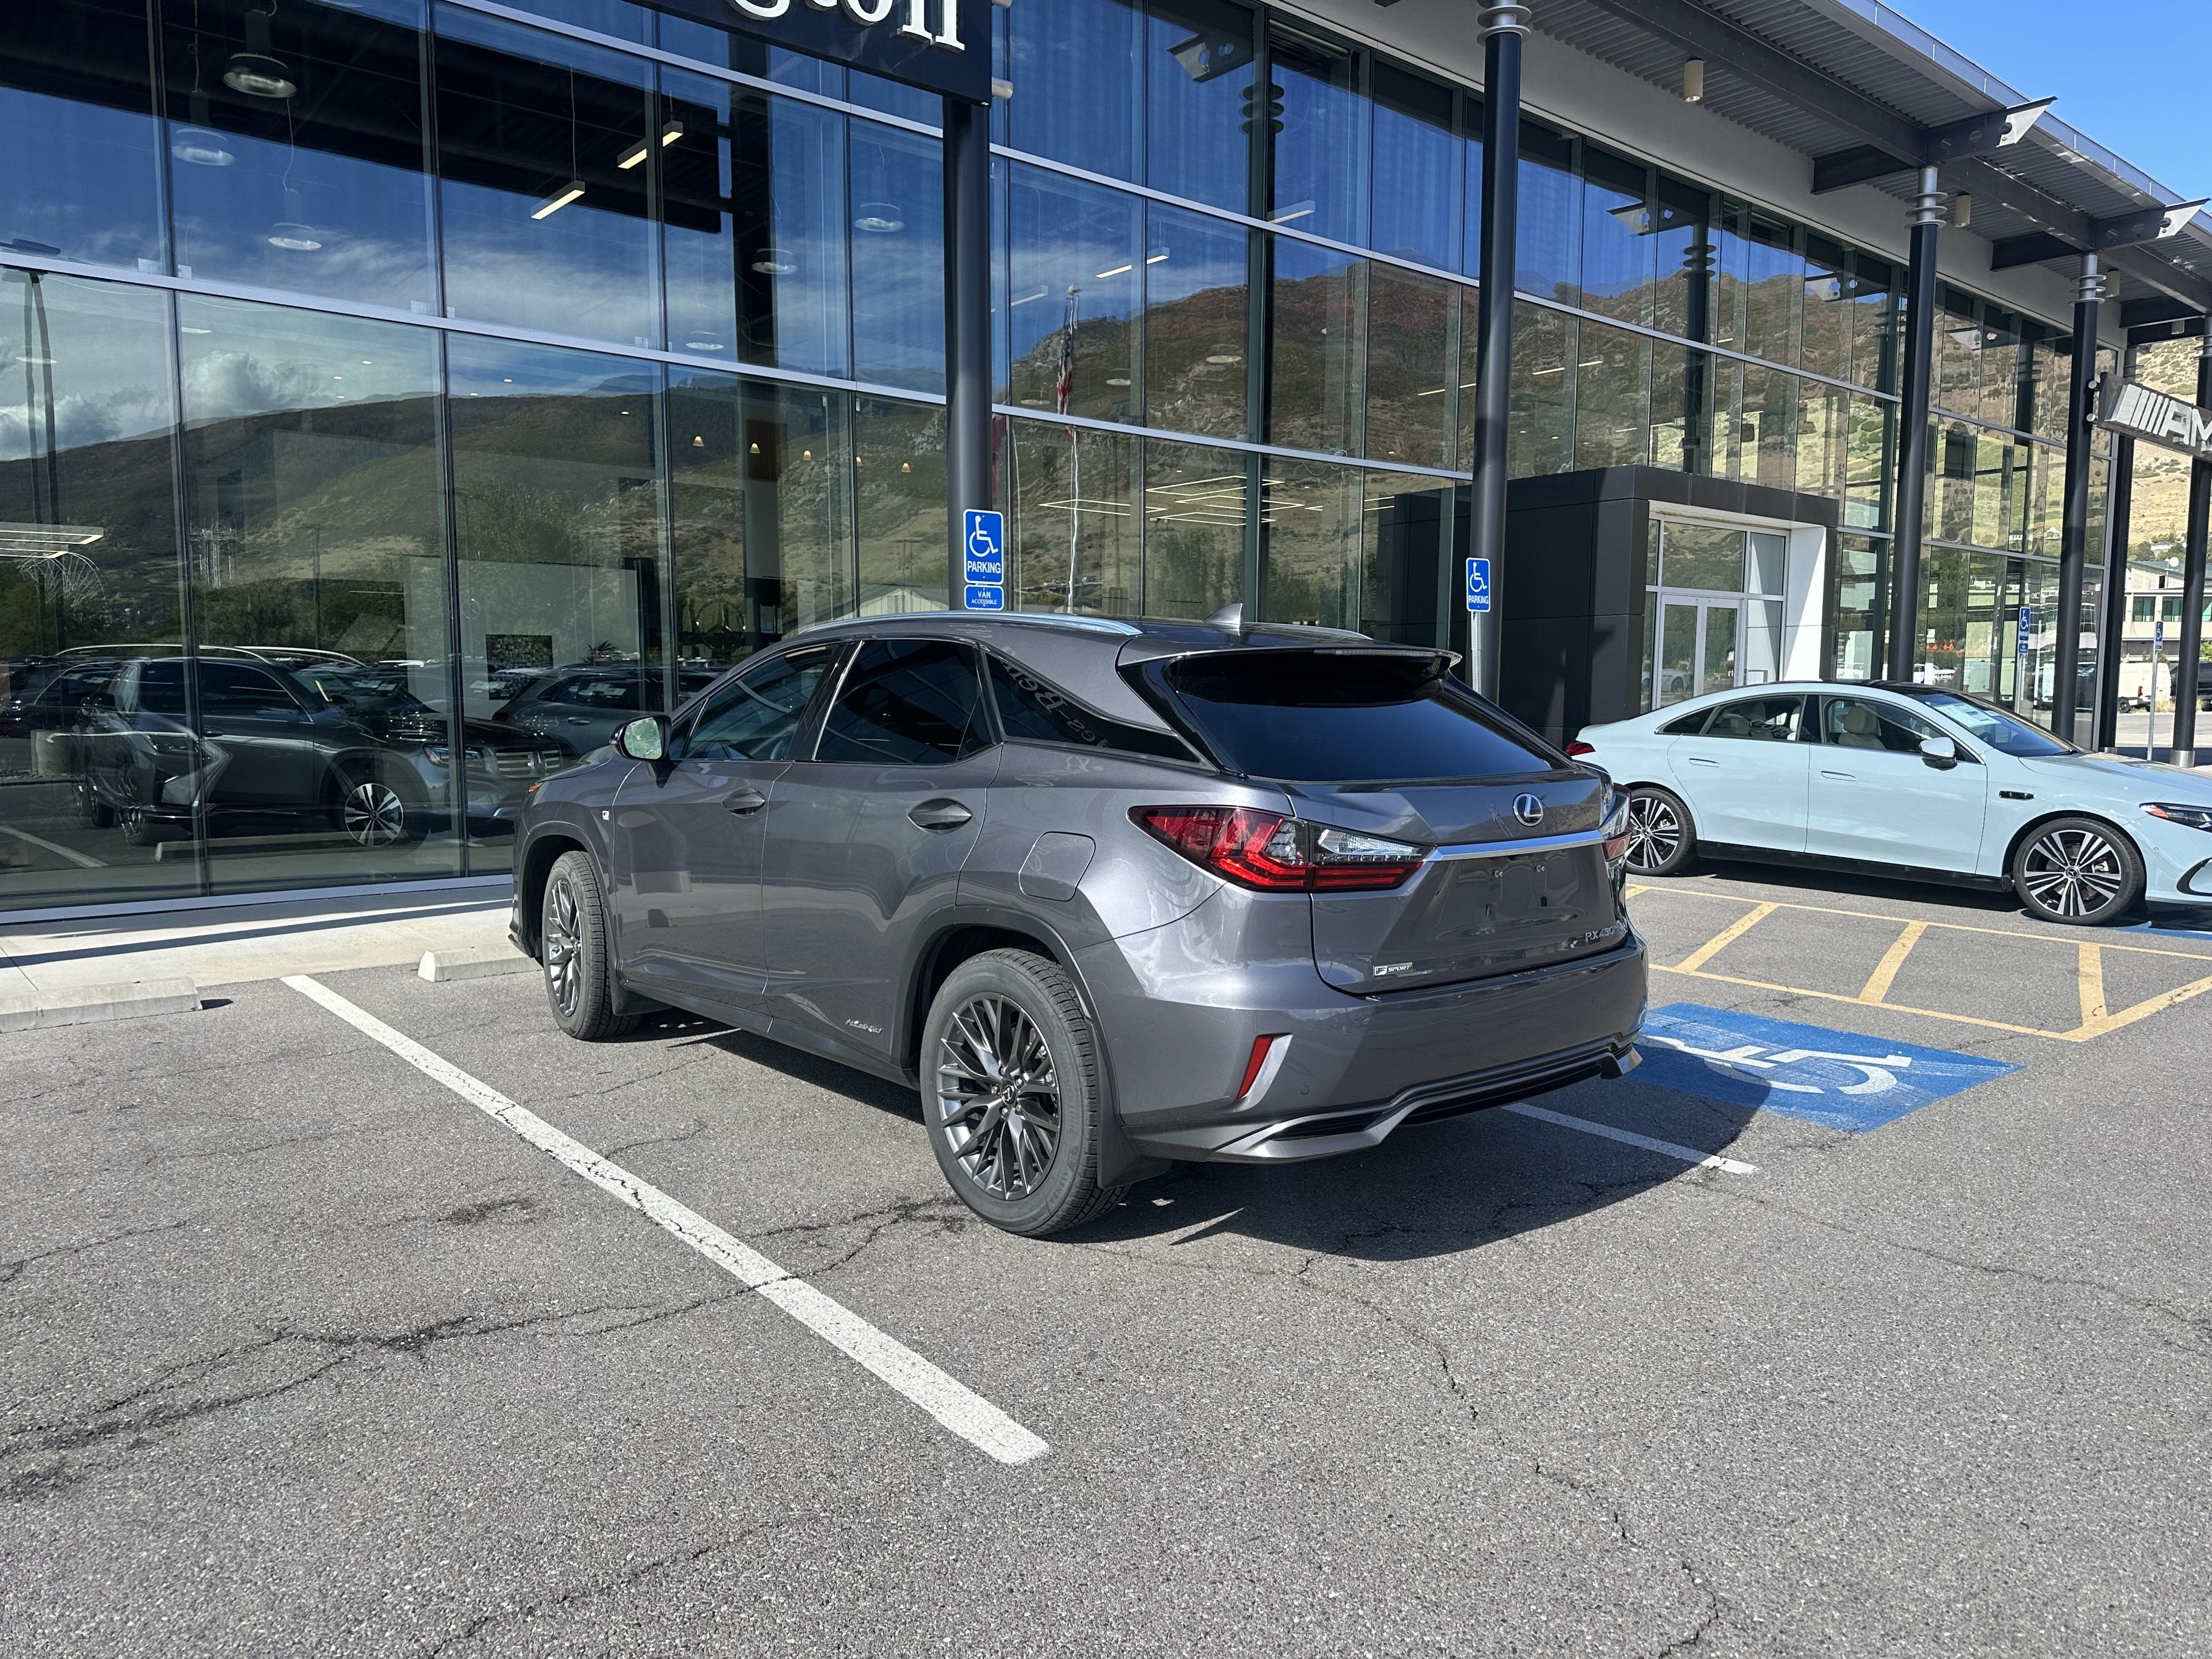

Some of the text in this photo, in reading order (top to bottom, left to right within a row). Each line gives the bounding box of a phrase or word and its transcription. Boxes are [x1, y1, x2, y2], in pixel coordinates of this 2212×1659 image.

[967, 560, 1001, 574] PARKING
[978, 590, 991, 599] VAN
[1468, 595, 1489, 604] PARKING
[1584, 930, 1599, 943] RX
